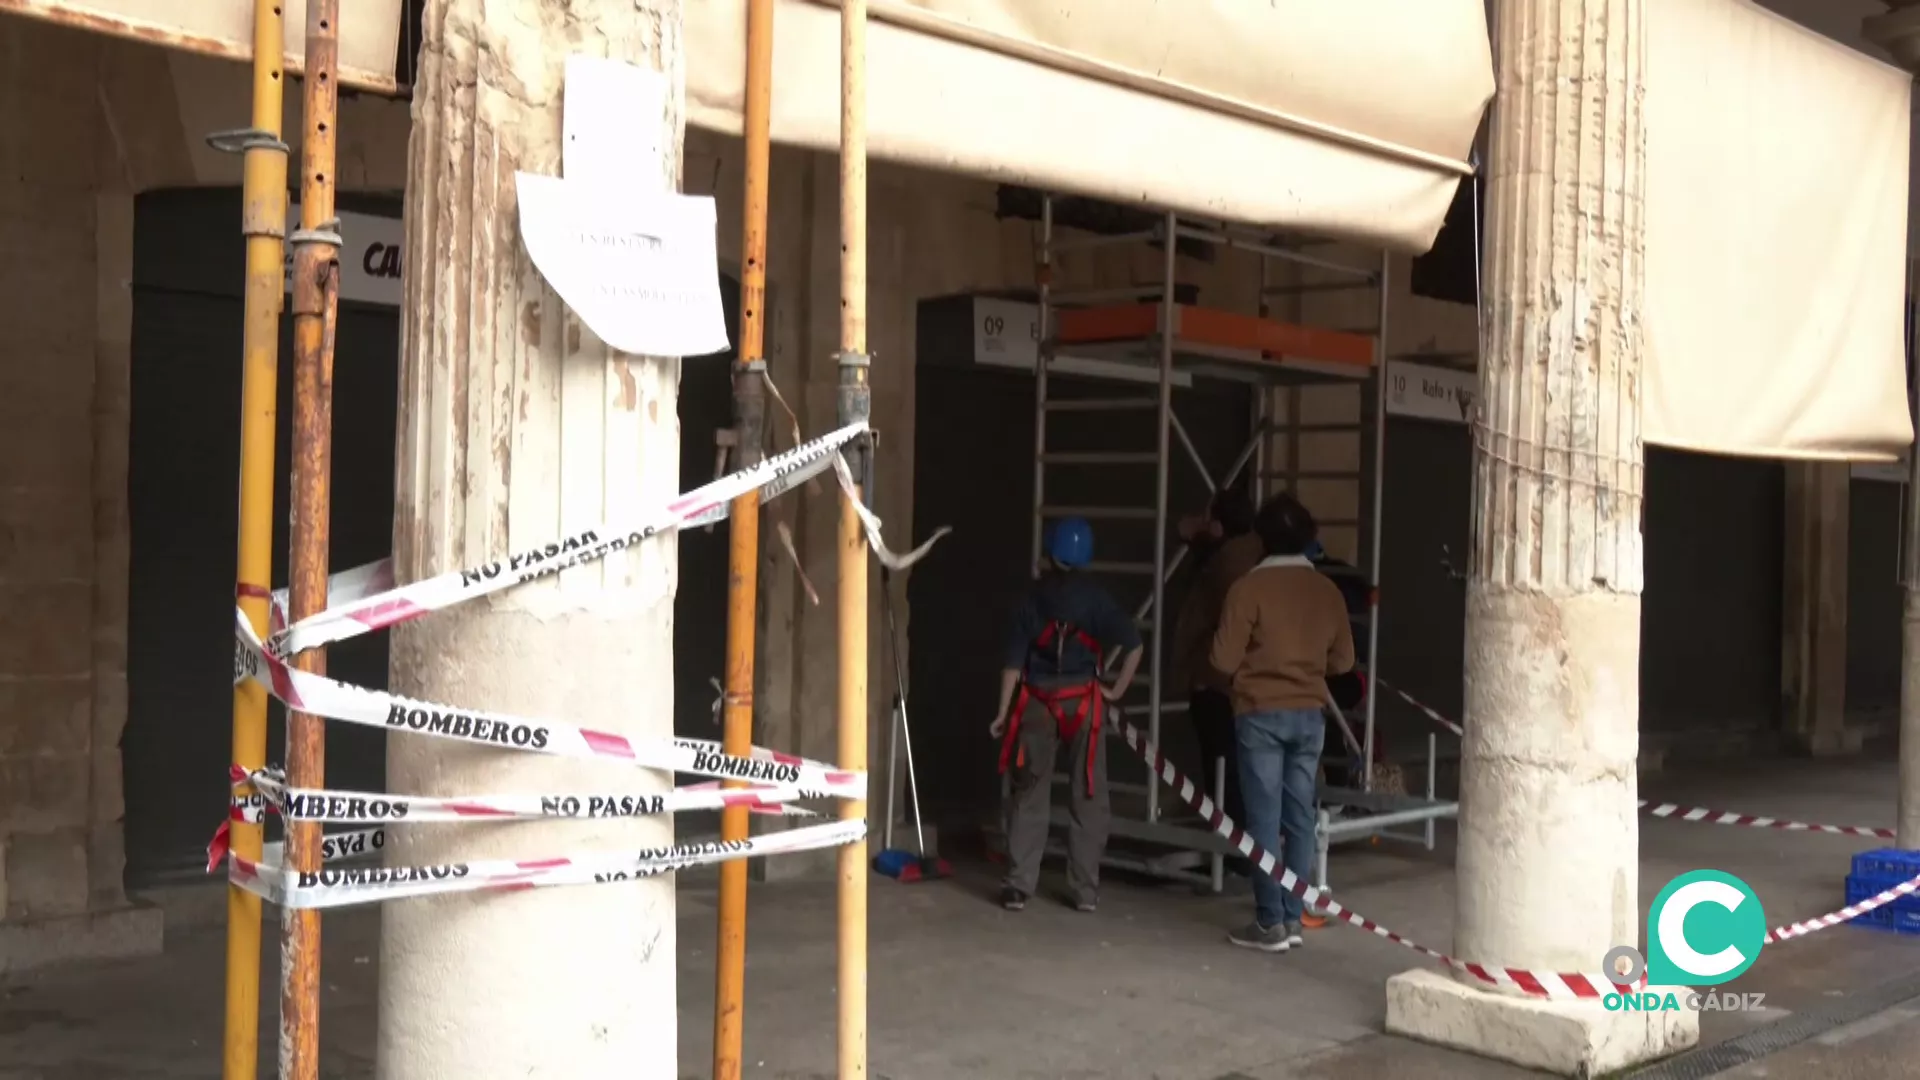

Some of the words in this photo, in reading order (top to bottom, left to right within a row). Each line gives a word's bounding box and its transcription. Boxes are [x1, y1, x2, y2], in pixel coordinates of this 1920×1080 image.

[363, 242, 402, 279] CA
[984, 316, 1004, 336] 09
[1393, 374, 1406, 392] 10
[460, 561, 501, 588] NO
[386, 702, 549, 749] BOMBEROS
[693, 750, 800, 782] BOMBEROS
[540, 796, 580, 817] NO
[588, 795, 664, 818] PASAR
